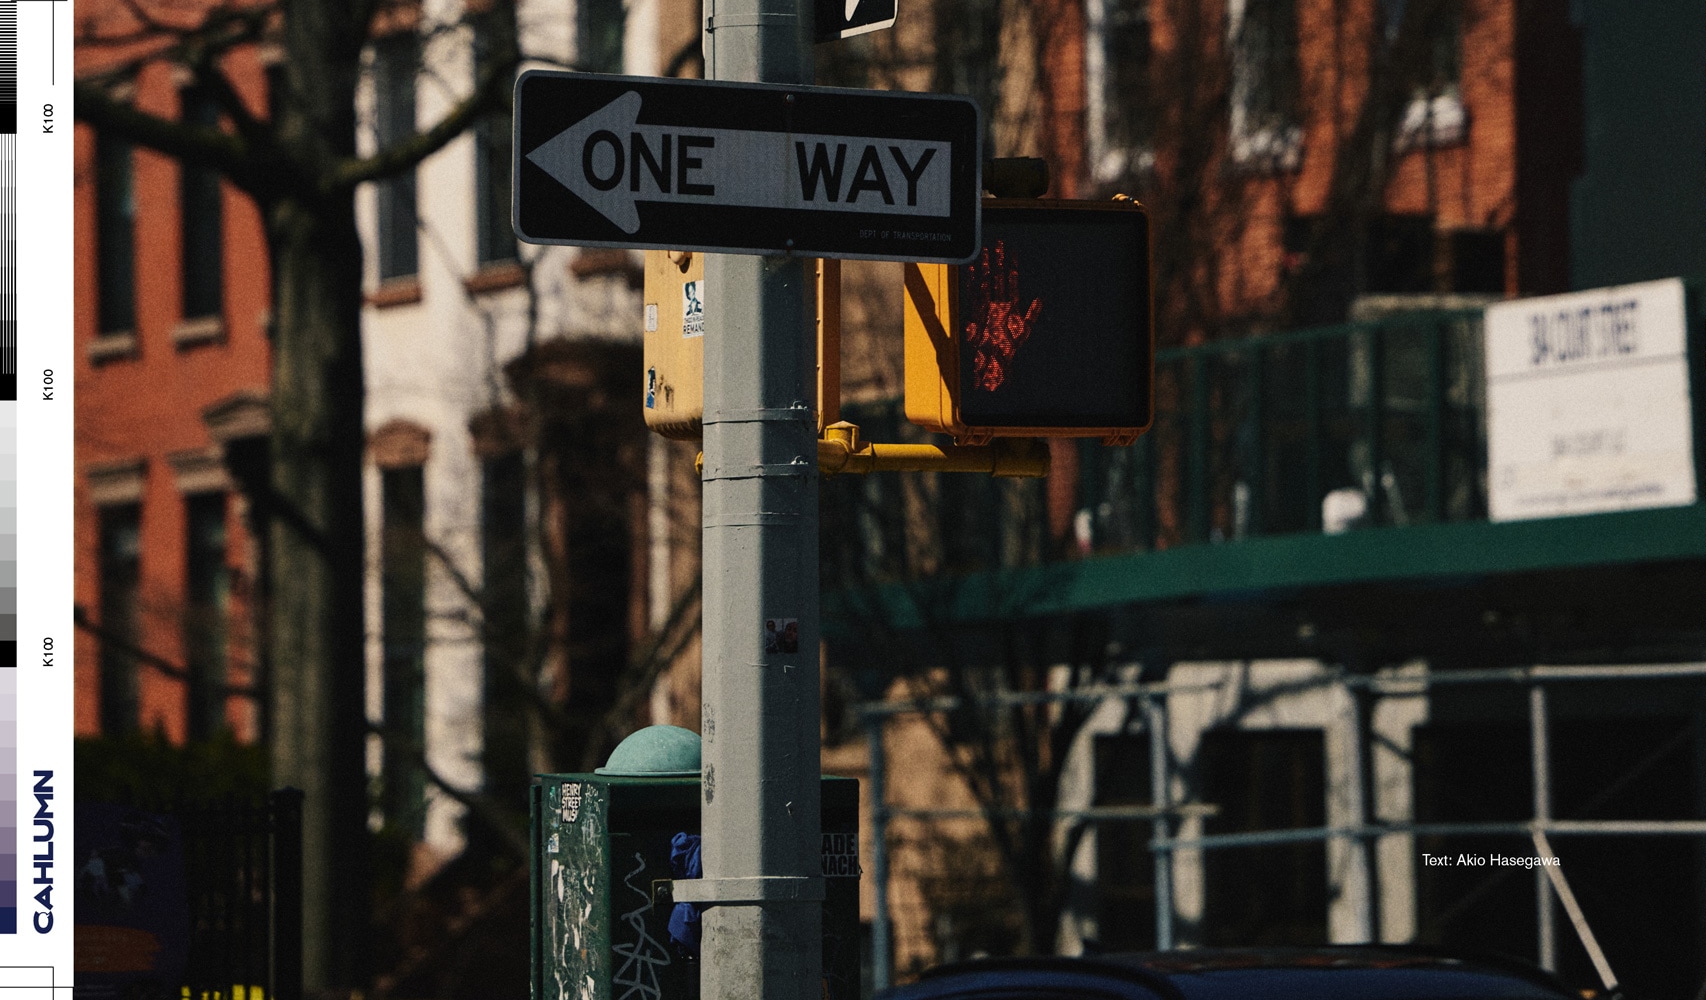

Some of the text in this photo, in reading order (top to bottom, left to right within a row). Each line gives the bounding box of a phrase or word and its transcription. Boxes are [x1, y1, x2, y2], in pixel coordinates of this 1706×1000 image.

[581, 128, 937, 208] ONE WAY
[880, 230, 890, 239] OF
[892, 230, 952, 242] TRANSPORTATION
